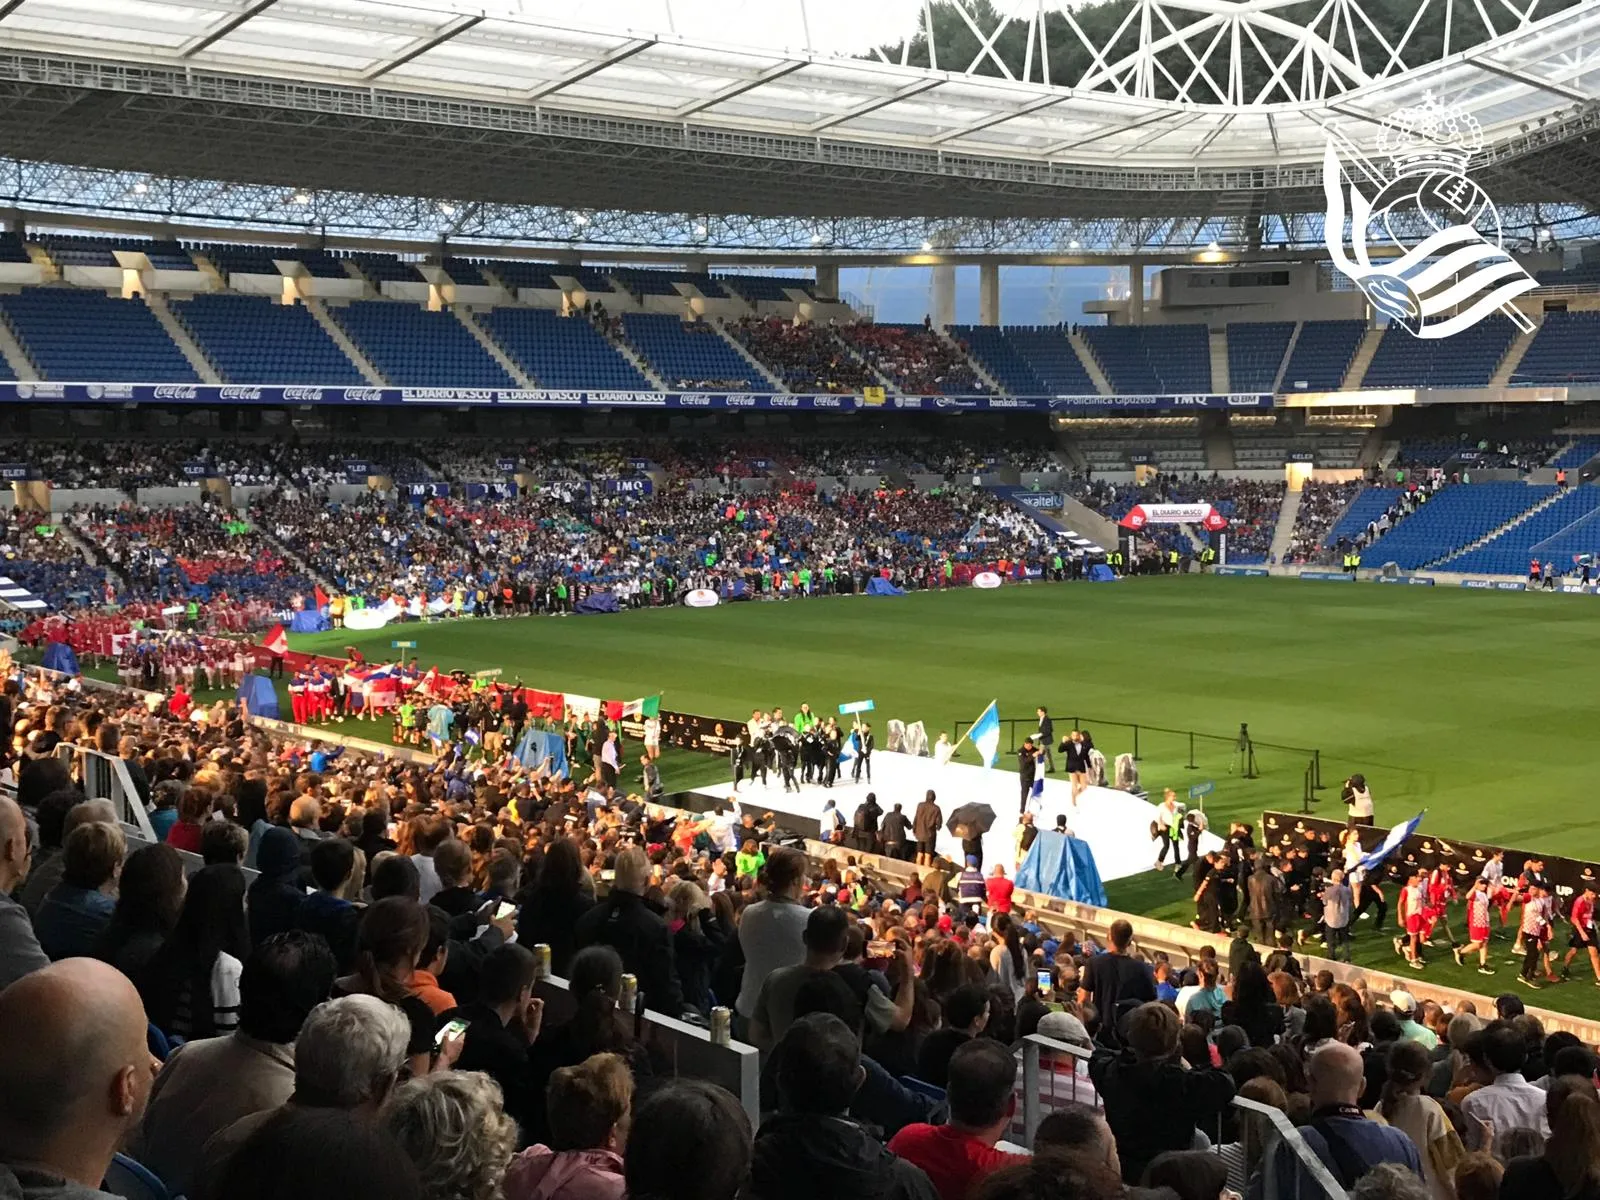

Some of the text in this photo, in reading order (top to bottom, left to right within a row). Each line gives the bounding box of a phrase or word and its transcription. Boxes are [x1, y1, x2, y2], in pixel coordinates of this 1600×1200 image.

[402, 389, 491, 399] EL DIARIO VASCO
[497, 391, 581, 400] EL DIARIO VASCO
[587, 392, 666, 401] EL DIARIO VASCO
